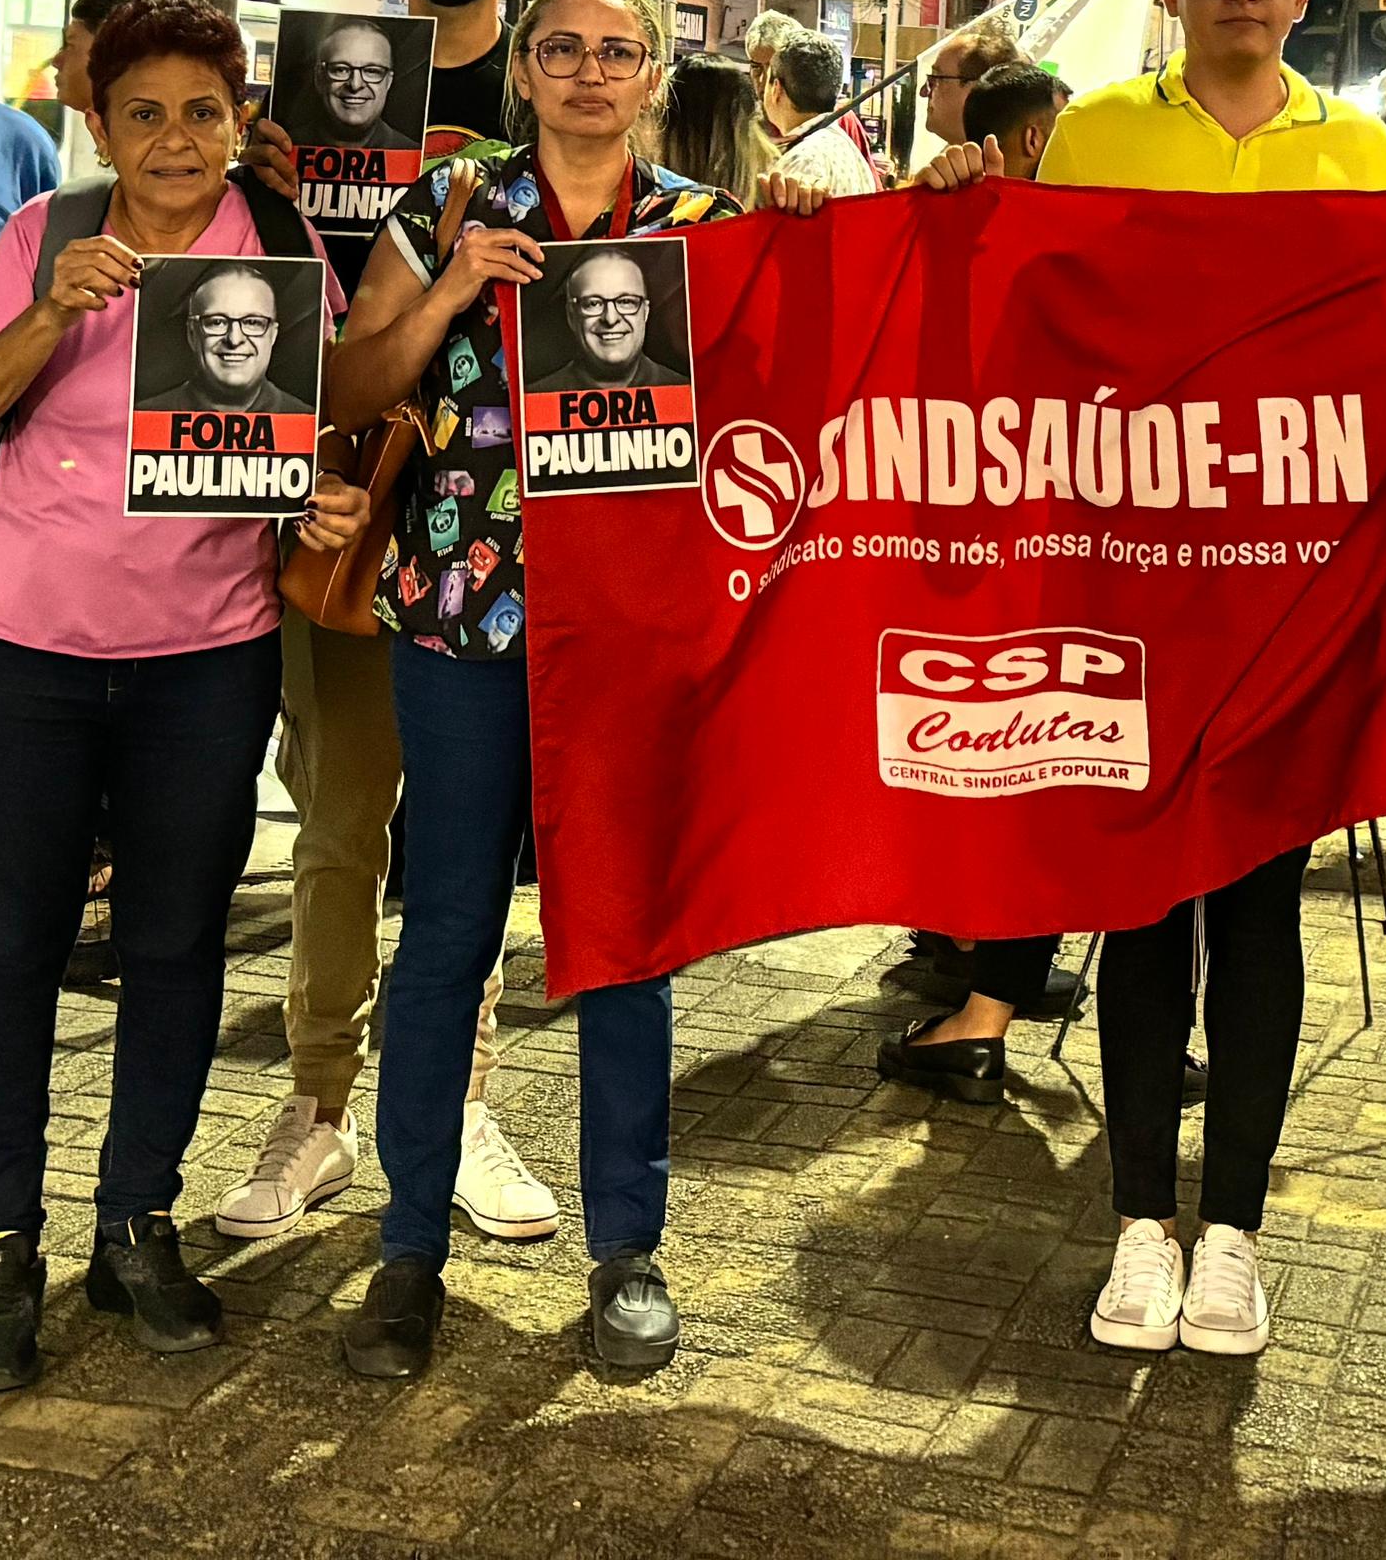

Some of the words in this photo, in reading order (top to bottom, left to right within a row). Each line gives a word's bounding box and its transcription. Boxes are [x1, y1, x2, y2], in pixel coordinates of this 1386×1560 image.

[296, 147, 386, 181] FORA
[559, 389, 657, 428] FORA
[170, 412, 275, 452] FORA
[529, 428, 692, 476] PAULINHO
[806, 385, 1368, 509] SINDSAÚDE-RN
[132, 456, 310, 498] PAULINHO
[728, 569, 751, 602] O
[852, 534, 941, 562] somos
[949, 534, 1006, 569] nós,
[1015, 532, 1093, 561] nossa
[1102, 531, 1168, 573] força
[1177, 543, 1192, 567] e
[1201, 541, 1287, 567] nossa
[1296, 540, 1340, 564] vo
[899, 643, 1126, 692] CSP
[906, 710, 1125, 753] Conlutas
[889, 765, 959, 787] CENTRAL
[963, 770, 1036, 789] SINDICAL
[1038, 767, 1048, 780] E
[1051, 765, 1130, 781] POPULAR
